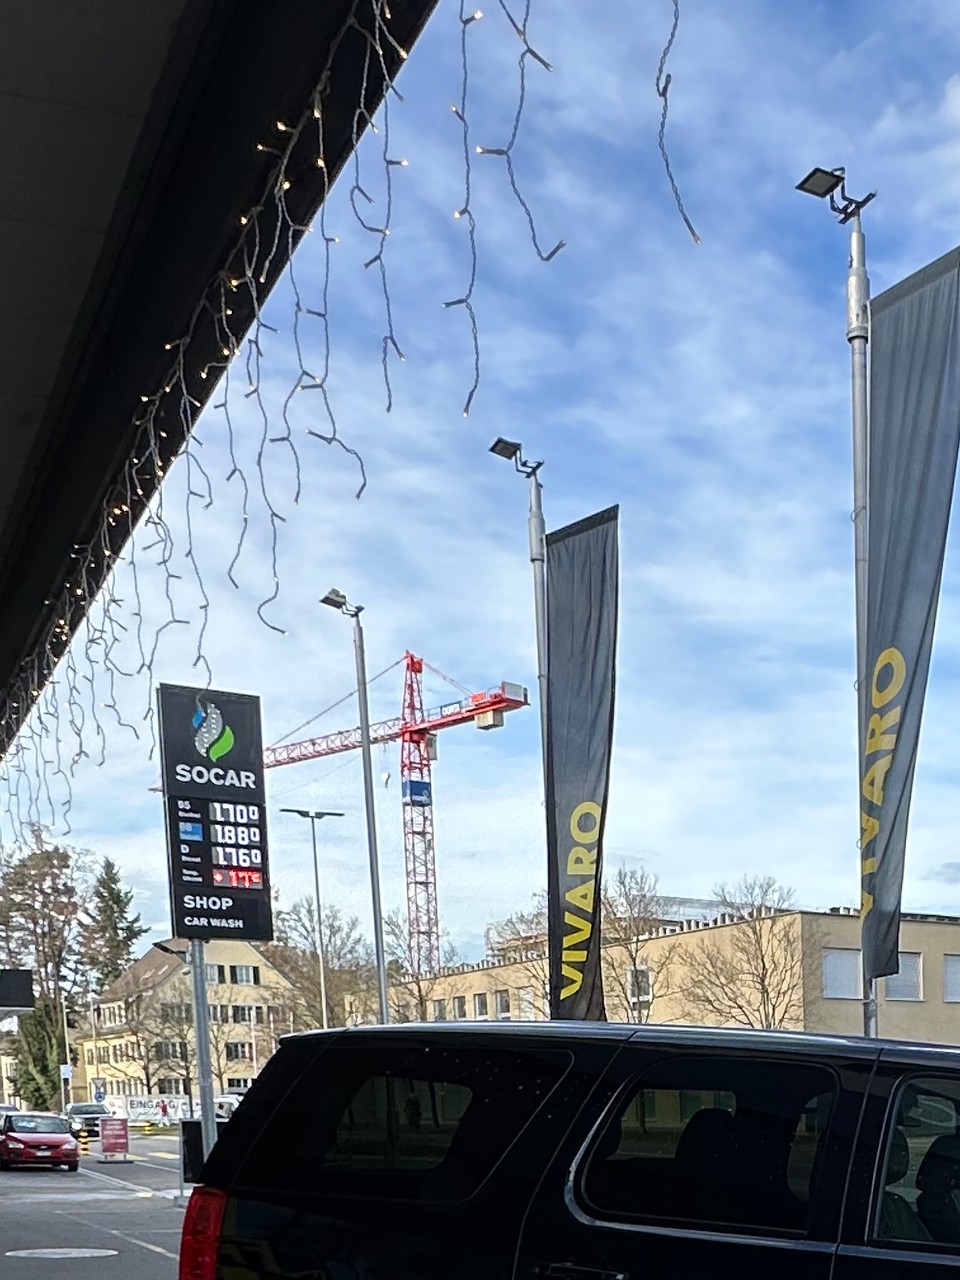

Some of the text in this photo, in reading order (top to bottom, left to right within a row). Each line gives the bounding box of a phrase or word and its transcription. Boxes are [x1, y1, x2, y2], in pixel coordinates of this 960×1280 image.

[175, 763, 256, 789] SOCAR
[183, 894, 234, 911] SHOP
[560, 801, 602, 1000] VIVARO
[184, 916, 244, 930] CAR WASH
[129, 1099, 176, 1109] EINGAG
